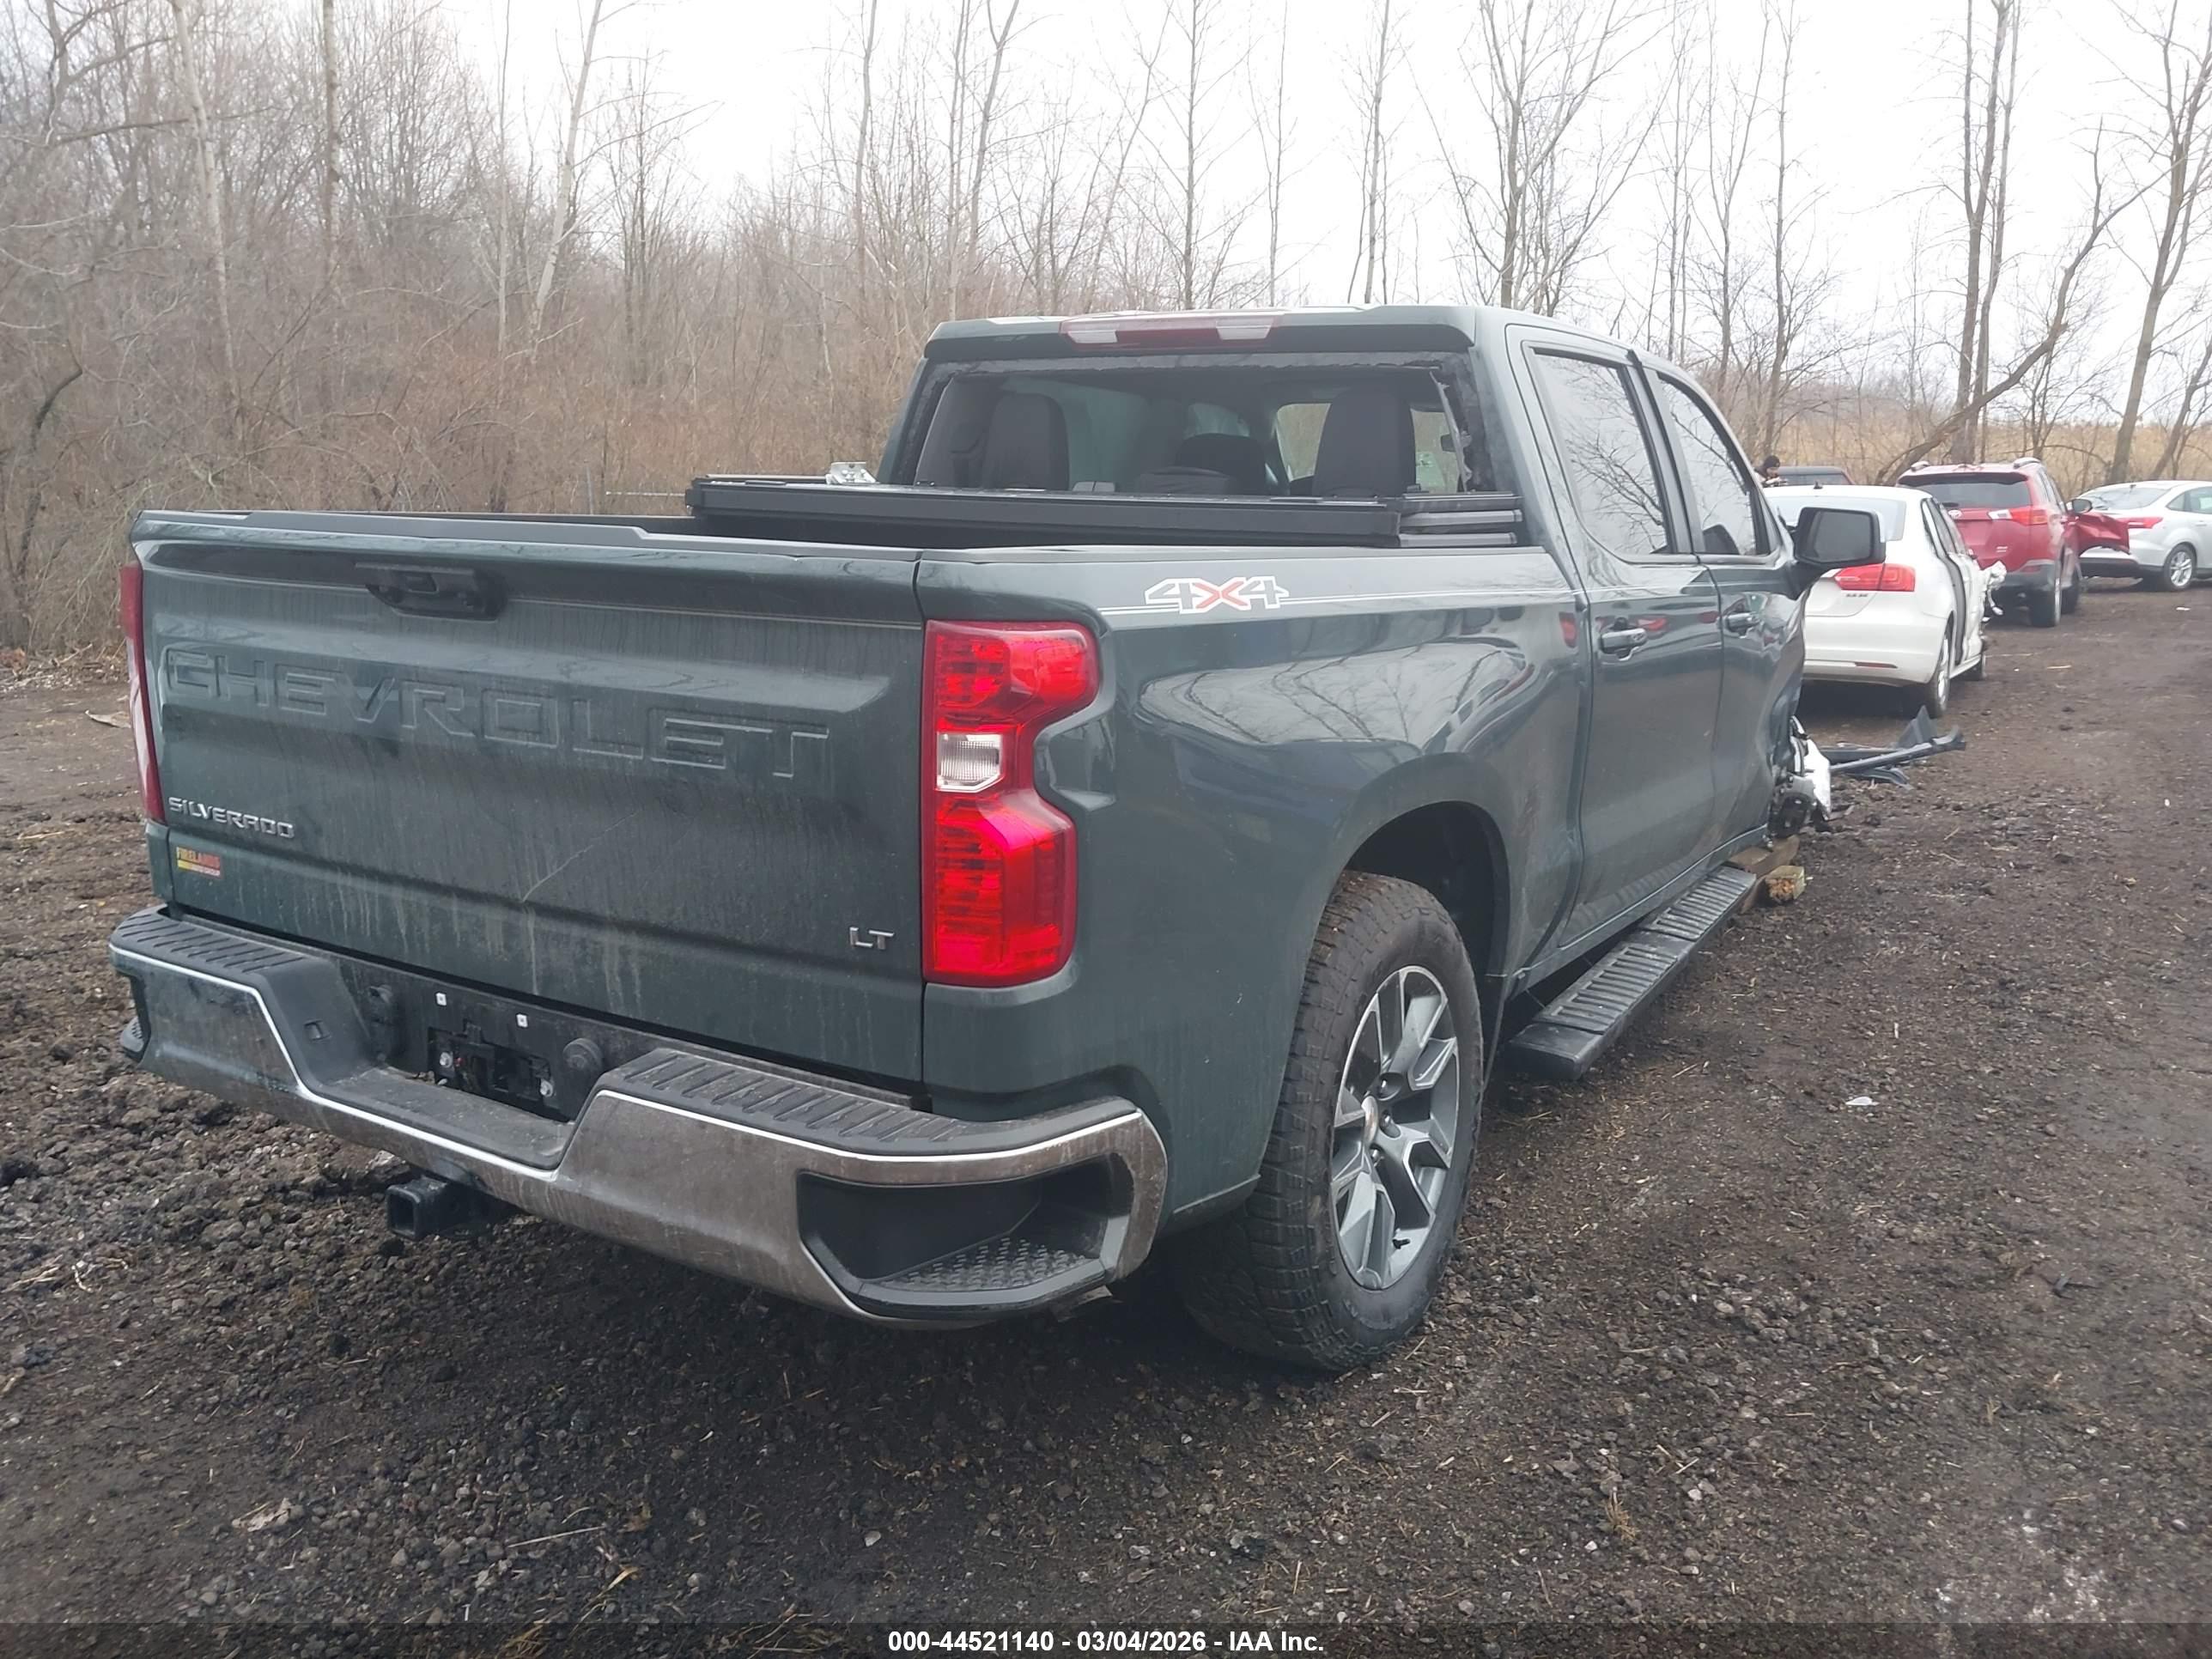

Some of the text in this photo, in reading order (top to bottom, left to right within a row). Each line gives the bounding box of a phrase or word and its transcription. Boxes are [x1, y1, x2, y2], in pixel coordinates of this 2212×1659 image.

[166, 647, 830, 778] CHEVROLET
[168, 797, 295, 839] SILVERADO
[849, 927, 895, 950] LT
